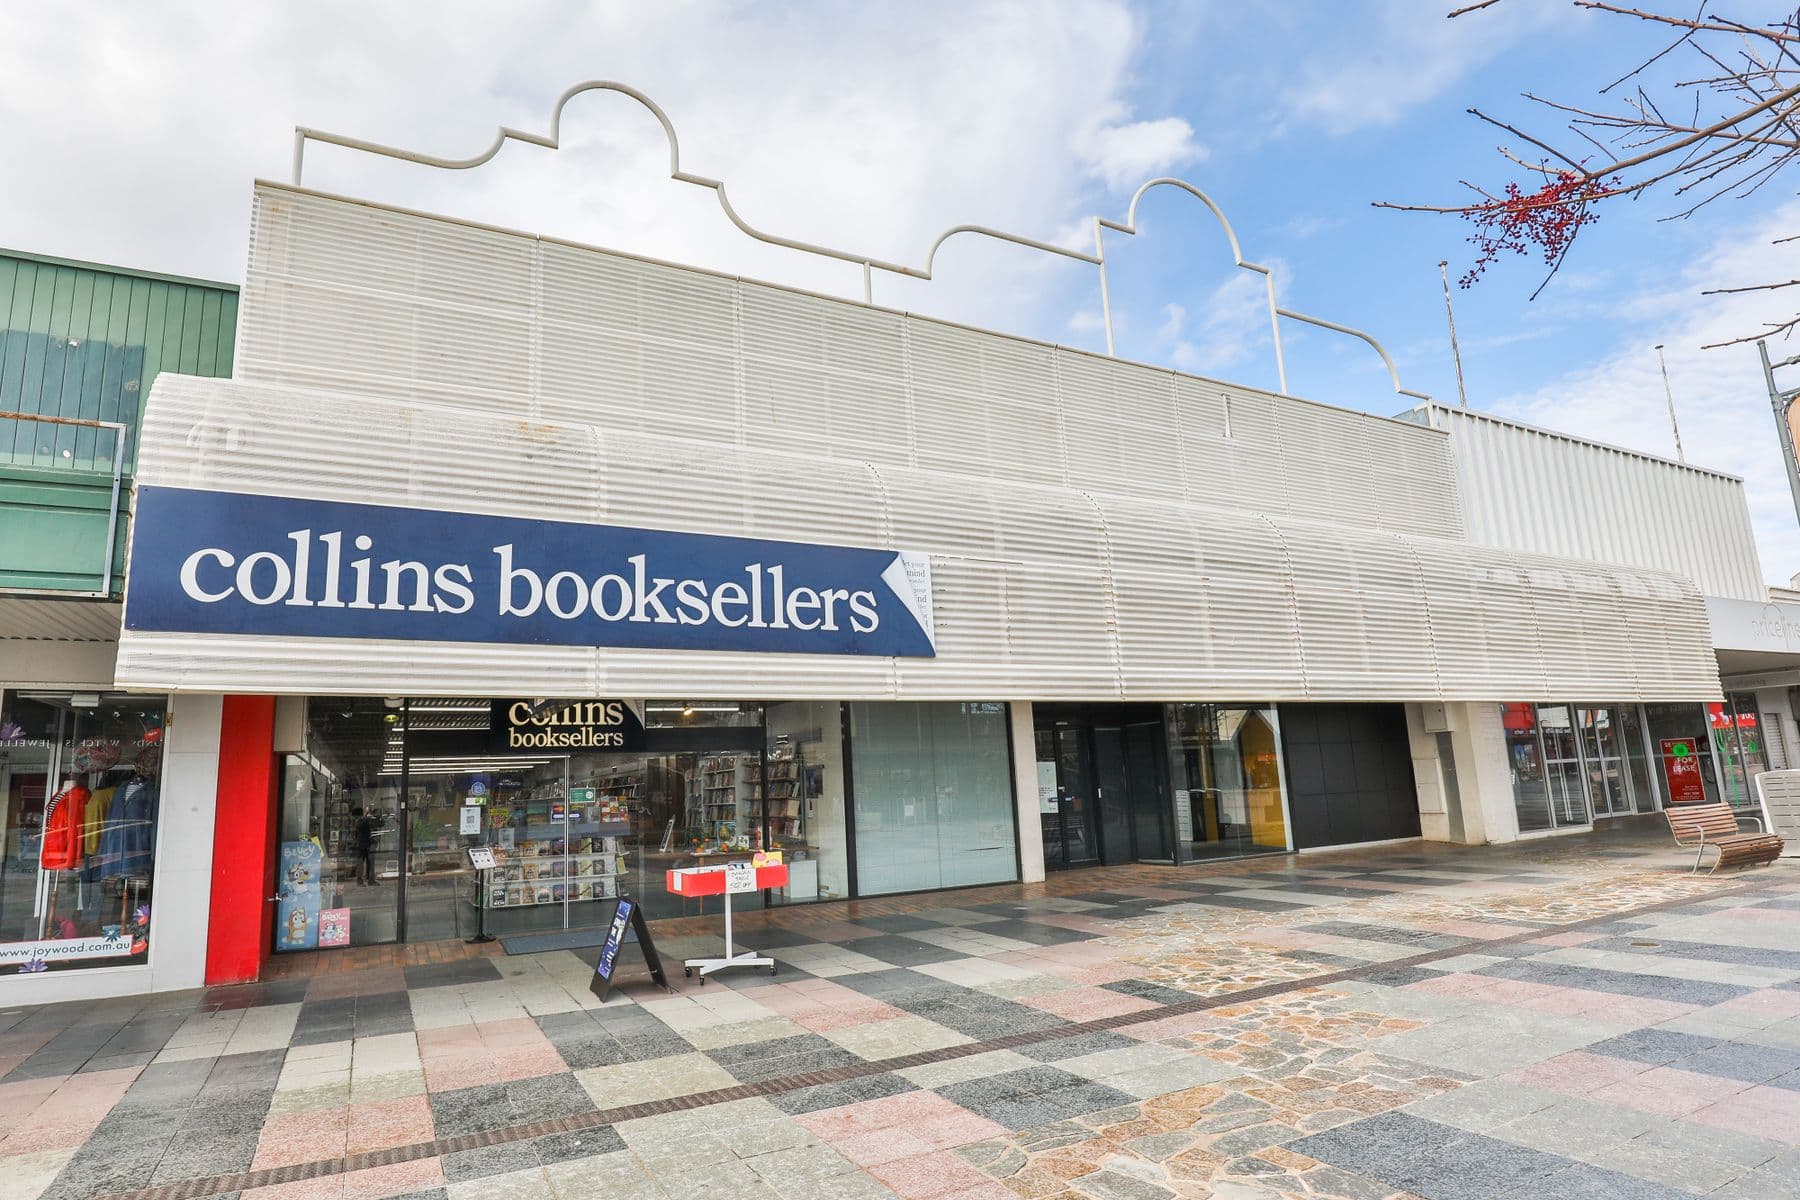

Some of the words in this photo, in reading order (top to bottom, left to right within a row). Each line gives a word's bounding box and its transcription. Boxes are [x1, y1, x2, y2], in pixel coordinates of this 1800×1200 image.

[180, 528, 474, 614] collins
[493, 543, 880, 633] booksellers
[508, 727, 624, 748] booksellers
[1673, 764, 1696, 772] LEASE
[0, 942, 130, 958] www.joywood.com.au
